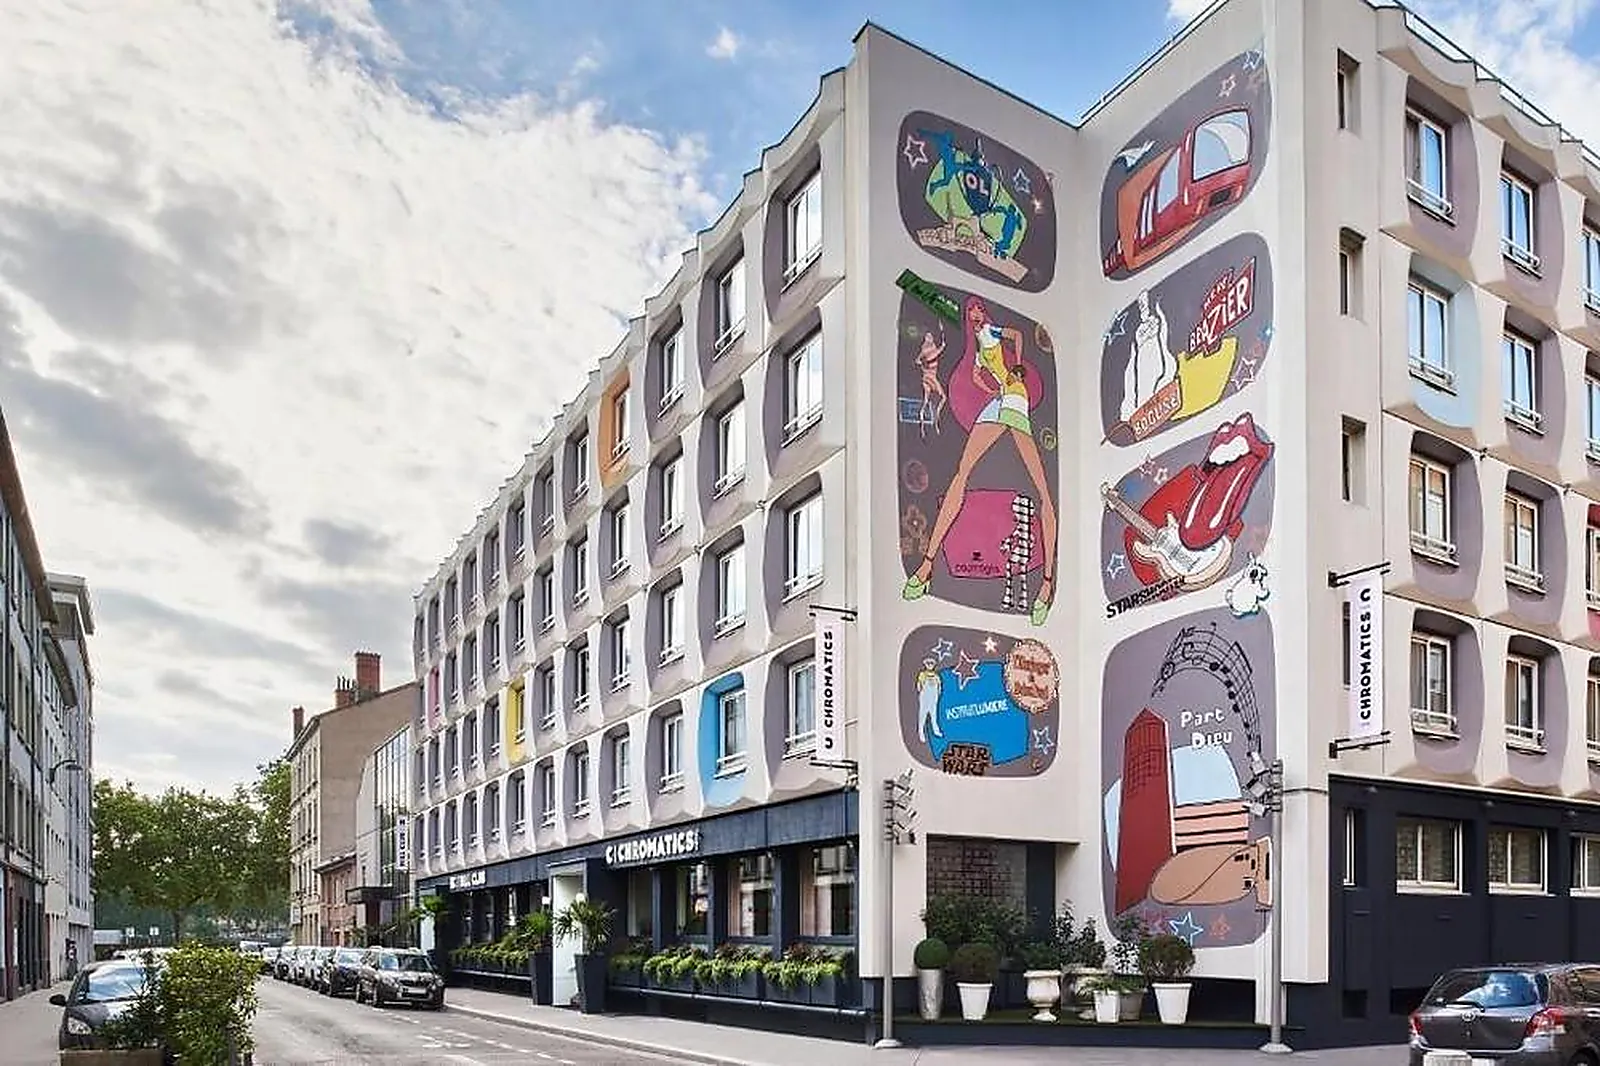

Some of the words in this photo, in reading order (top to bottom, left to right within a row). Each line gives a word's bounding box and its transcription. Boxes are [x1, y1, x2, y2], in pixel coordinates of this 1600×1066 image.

[965, 172, 989, 197] OL
[823, 631, 834, 728] CHROMATICS
[1360, 611, 1372, 721] CHROMATICS
[1181, 708, 1225, 728] Part
